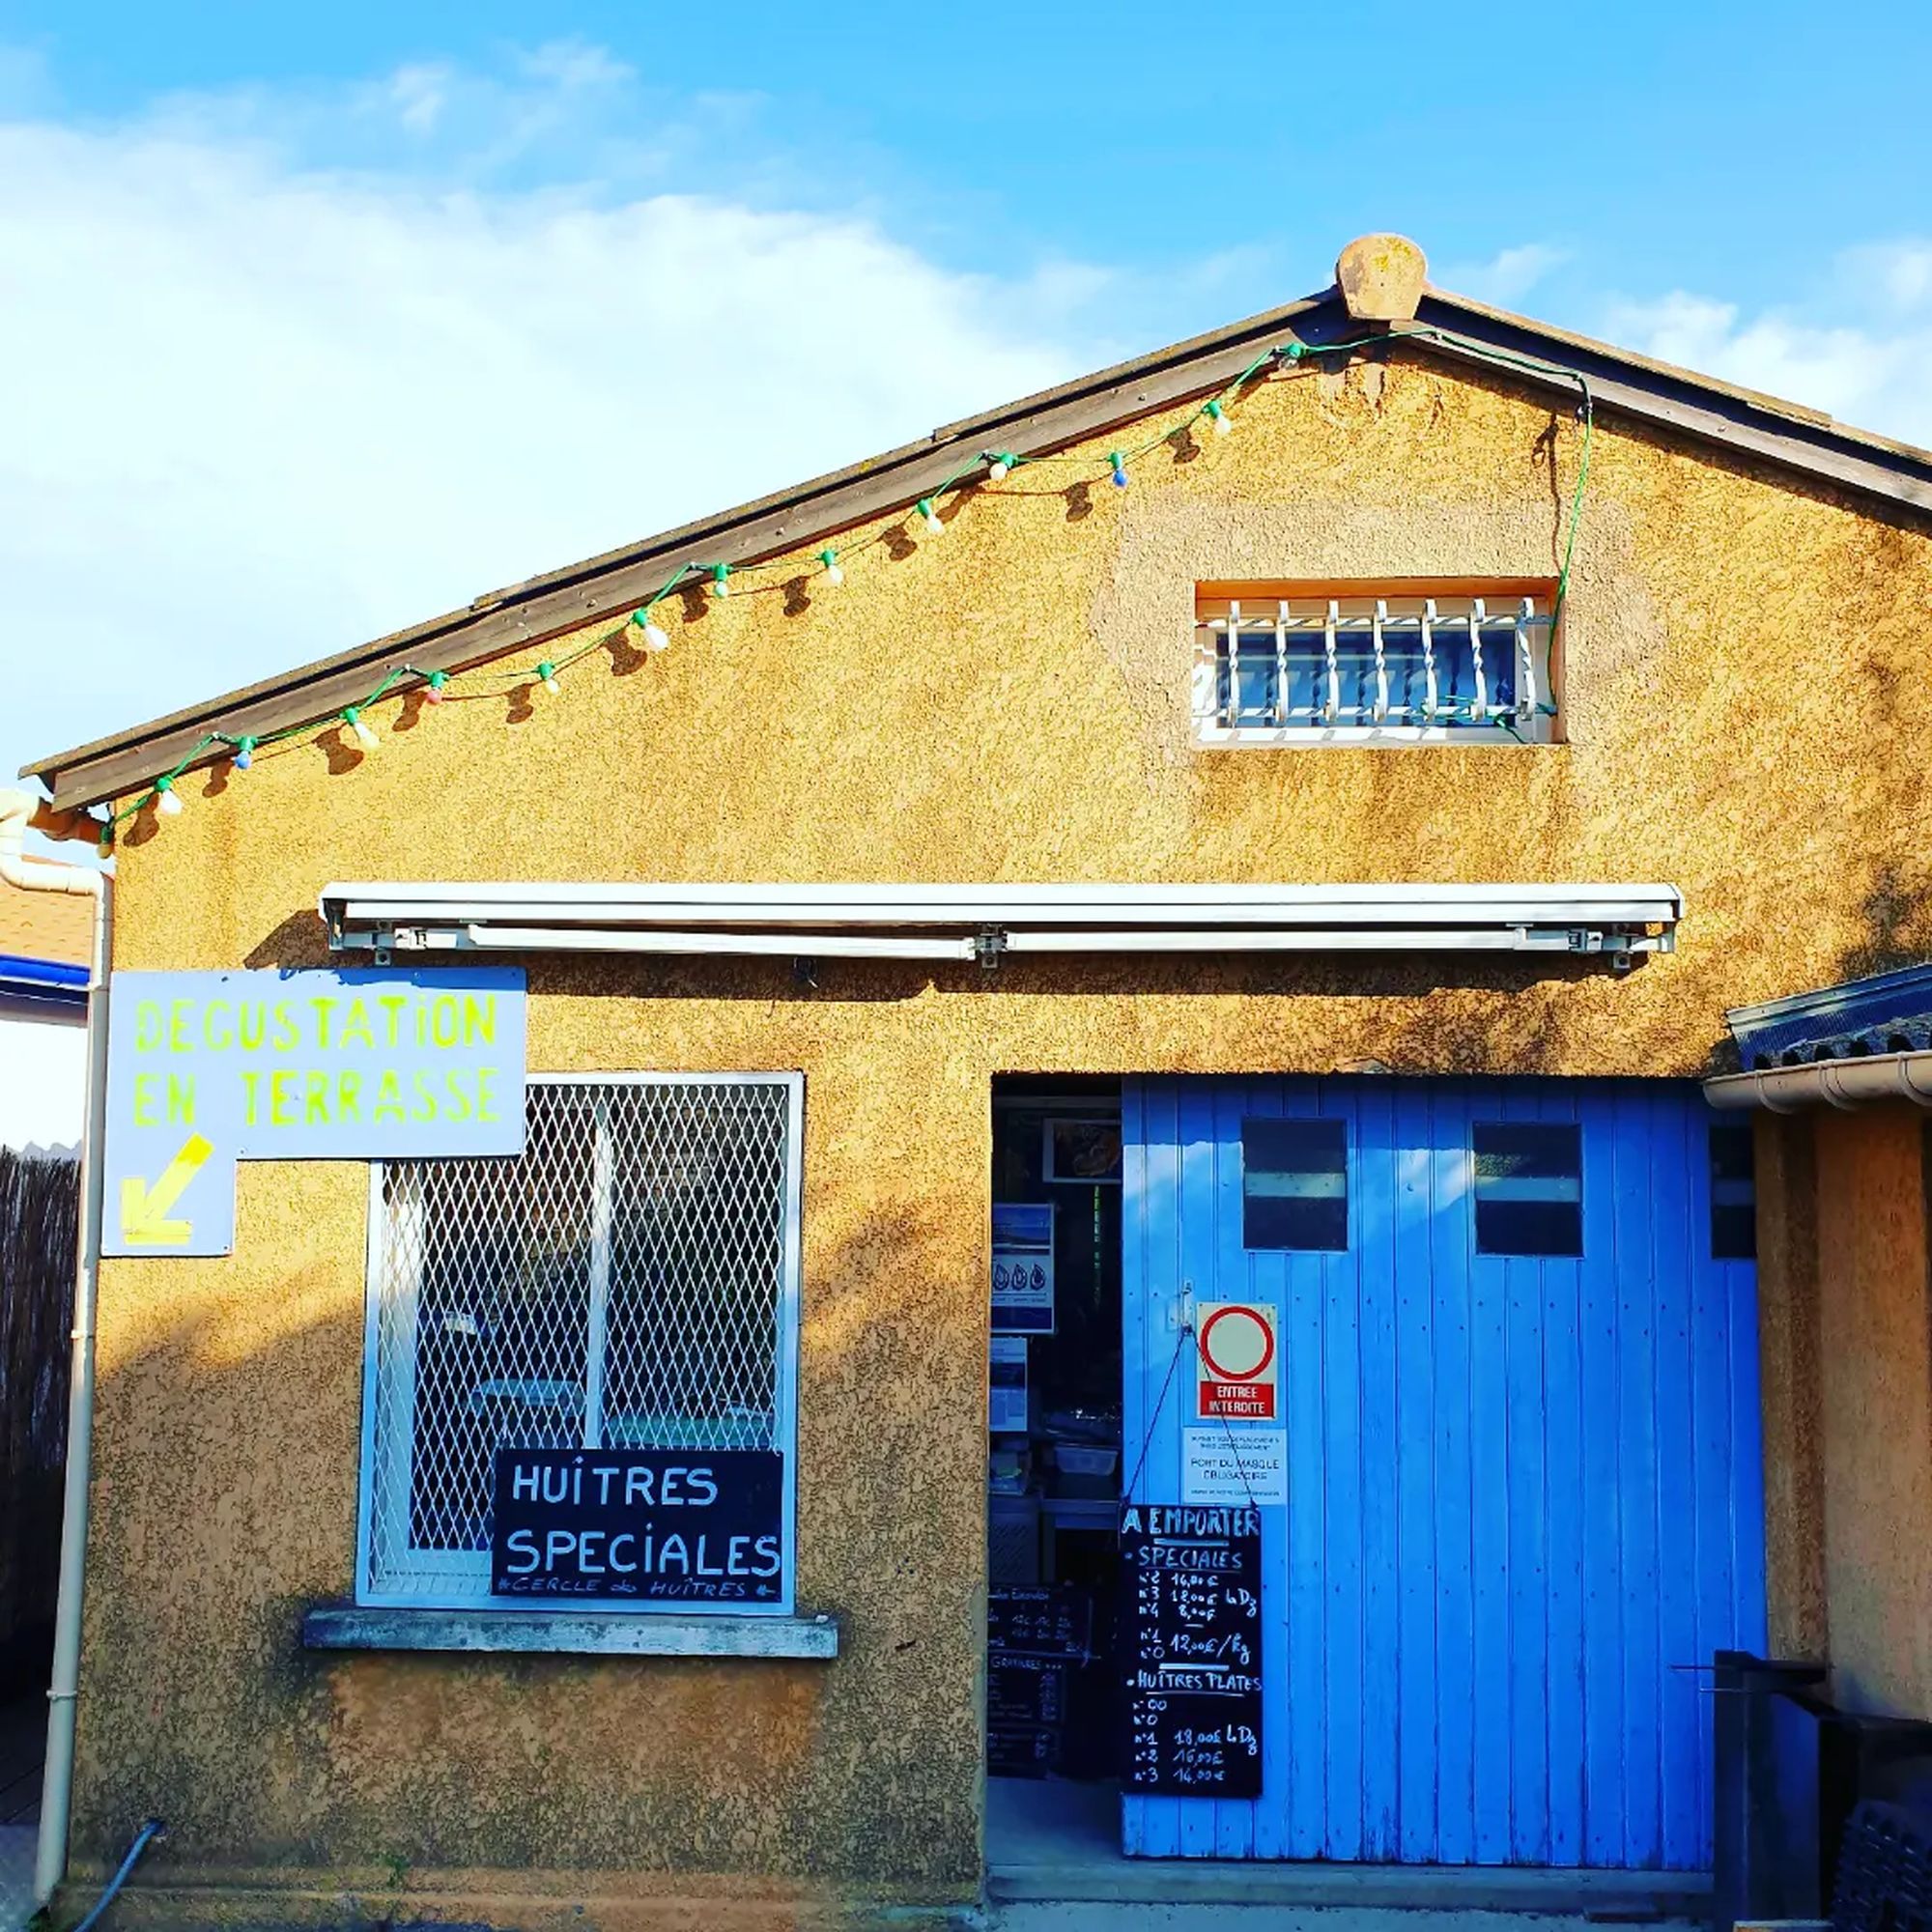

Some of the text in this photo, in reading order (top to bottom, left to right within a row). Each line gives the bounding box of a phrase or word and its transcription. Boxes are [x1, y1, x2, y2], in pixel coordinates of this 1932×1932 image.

[133, 1067, 501, 1127] EN TERRASSE
[1209, 1400, 1265, 1414] INTERDITE
[1122, 1508, 1260, 1537] A EMPORTER
[1138, 1546, 1242, 1569] SPECIALES
[512, 1577, 602, 1593] CERCLE
[1206, 1672, 1263, 1690] PLATES
